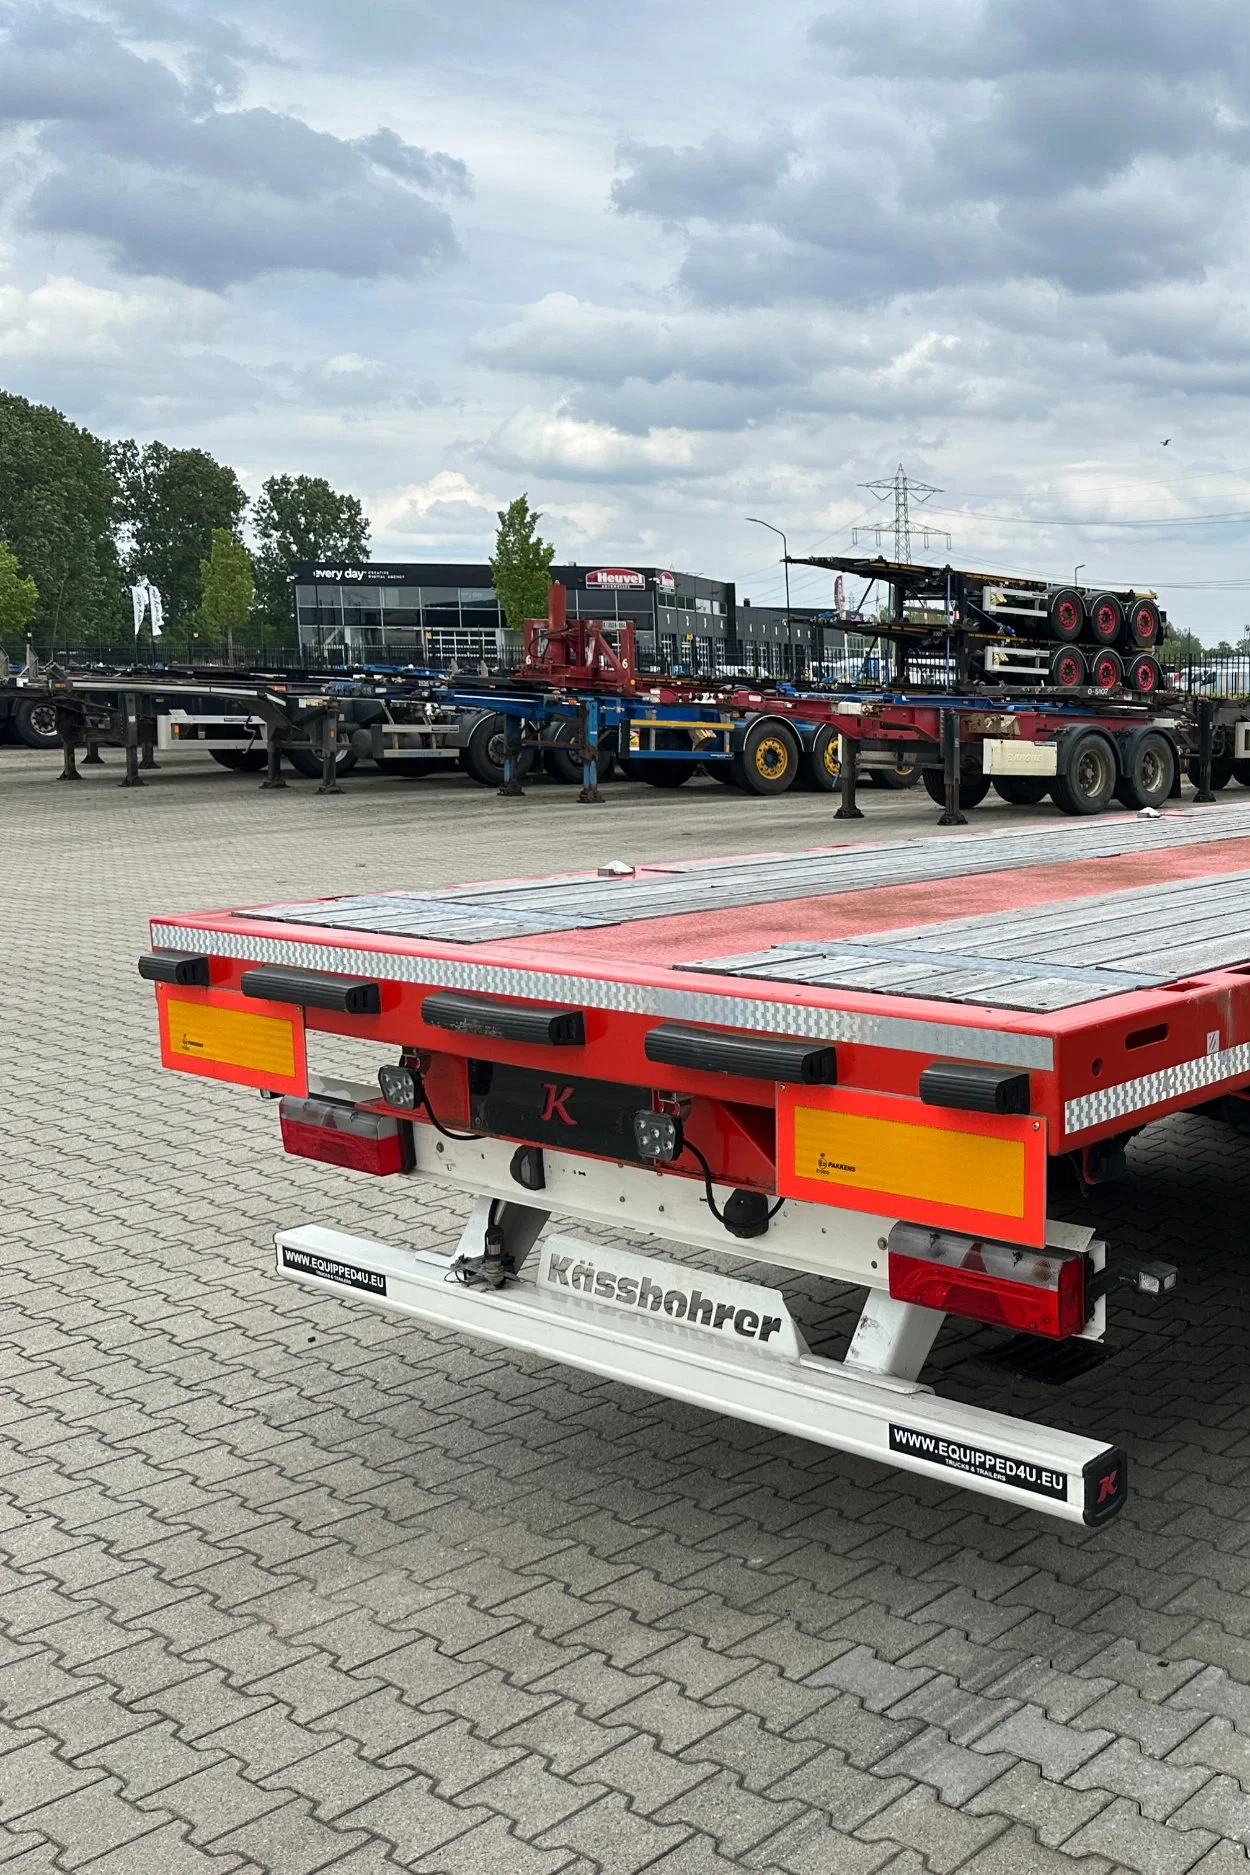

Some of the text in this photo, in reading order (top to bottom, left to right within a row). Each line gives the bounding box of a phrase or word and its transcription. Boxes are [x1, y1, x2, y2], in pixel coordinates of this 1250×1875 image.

[344, 568, 364, 580] day
[597, 572, 643, 584] Heuvel
[525, 654, 531, 665] 6
[622, 659, 628, 669] 6
[285, 1249, 384, 1288] WWW.EQUIPPED4U.EU
[547, 1253, 783, 1342] Kässbohrer
[893, 1428, 1064, 1490] WWW.EQUIPPED4U.EU
[945, 1458, 1006, 1482] TRUCKS & TRAILERS
